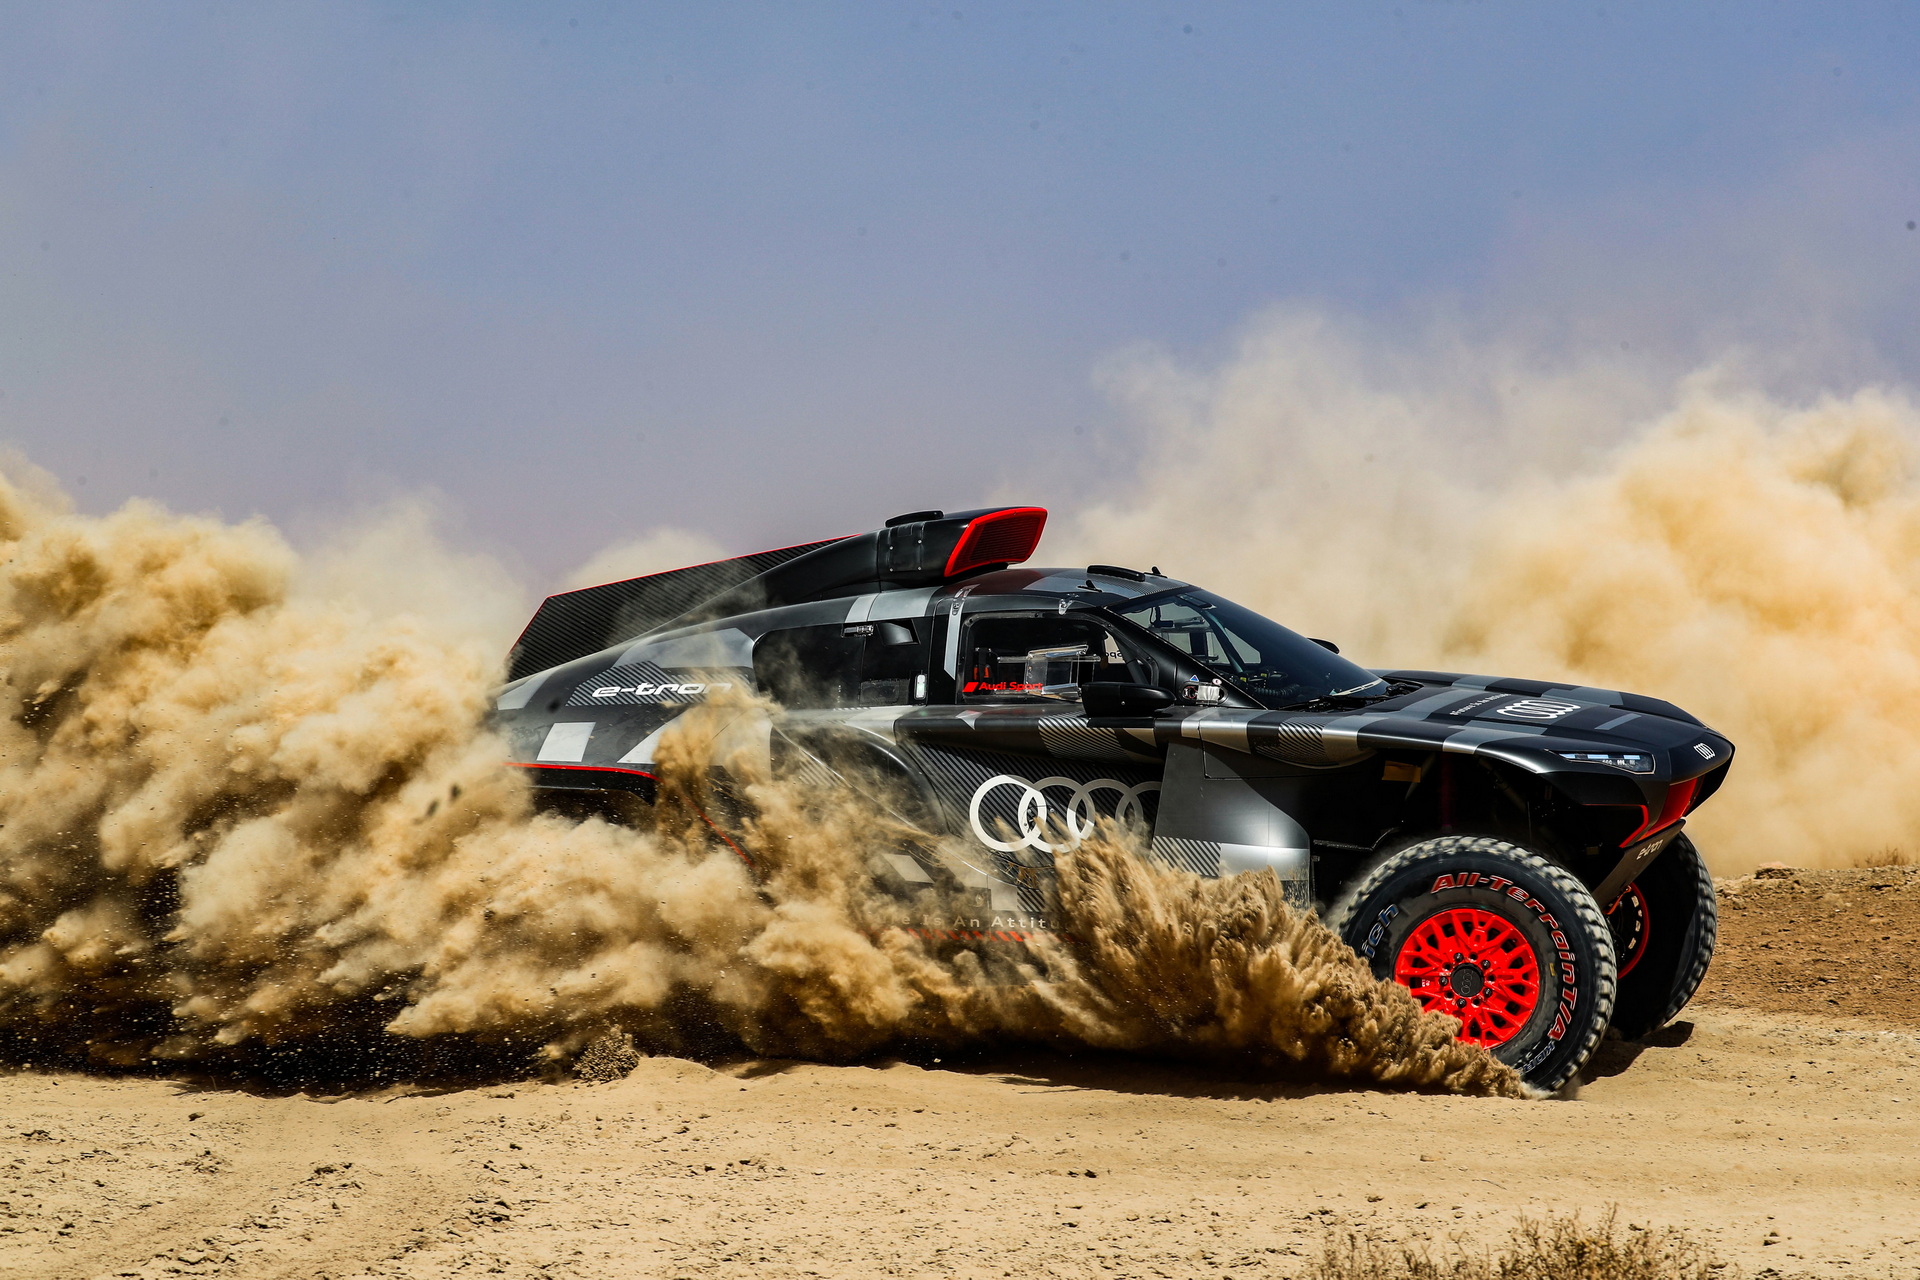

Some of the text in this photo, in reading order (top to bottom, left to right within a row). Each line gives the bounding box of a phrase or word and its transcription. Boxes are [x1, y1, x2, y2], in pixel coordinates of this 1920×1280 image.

[591, 682, 732, 698] e-tron
[979, 682, 1043, 692] Audi Sport
[922, 914, 942, 926] Is
[953, 915, 980, 928] An
[991, 915, 1060, 929] Attitu
[1361, 904, 1399, 958] ich
